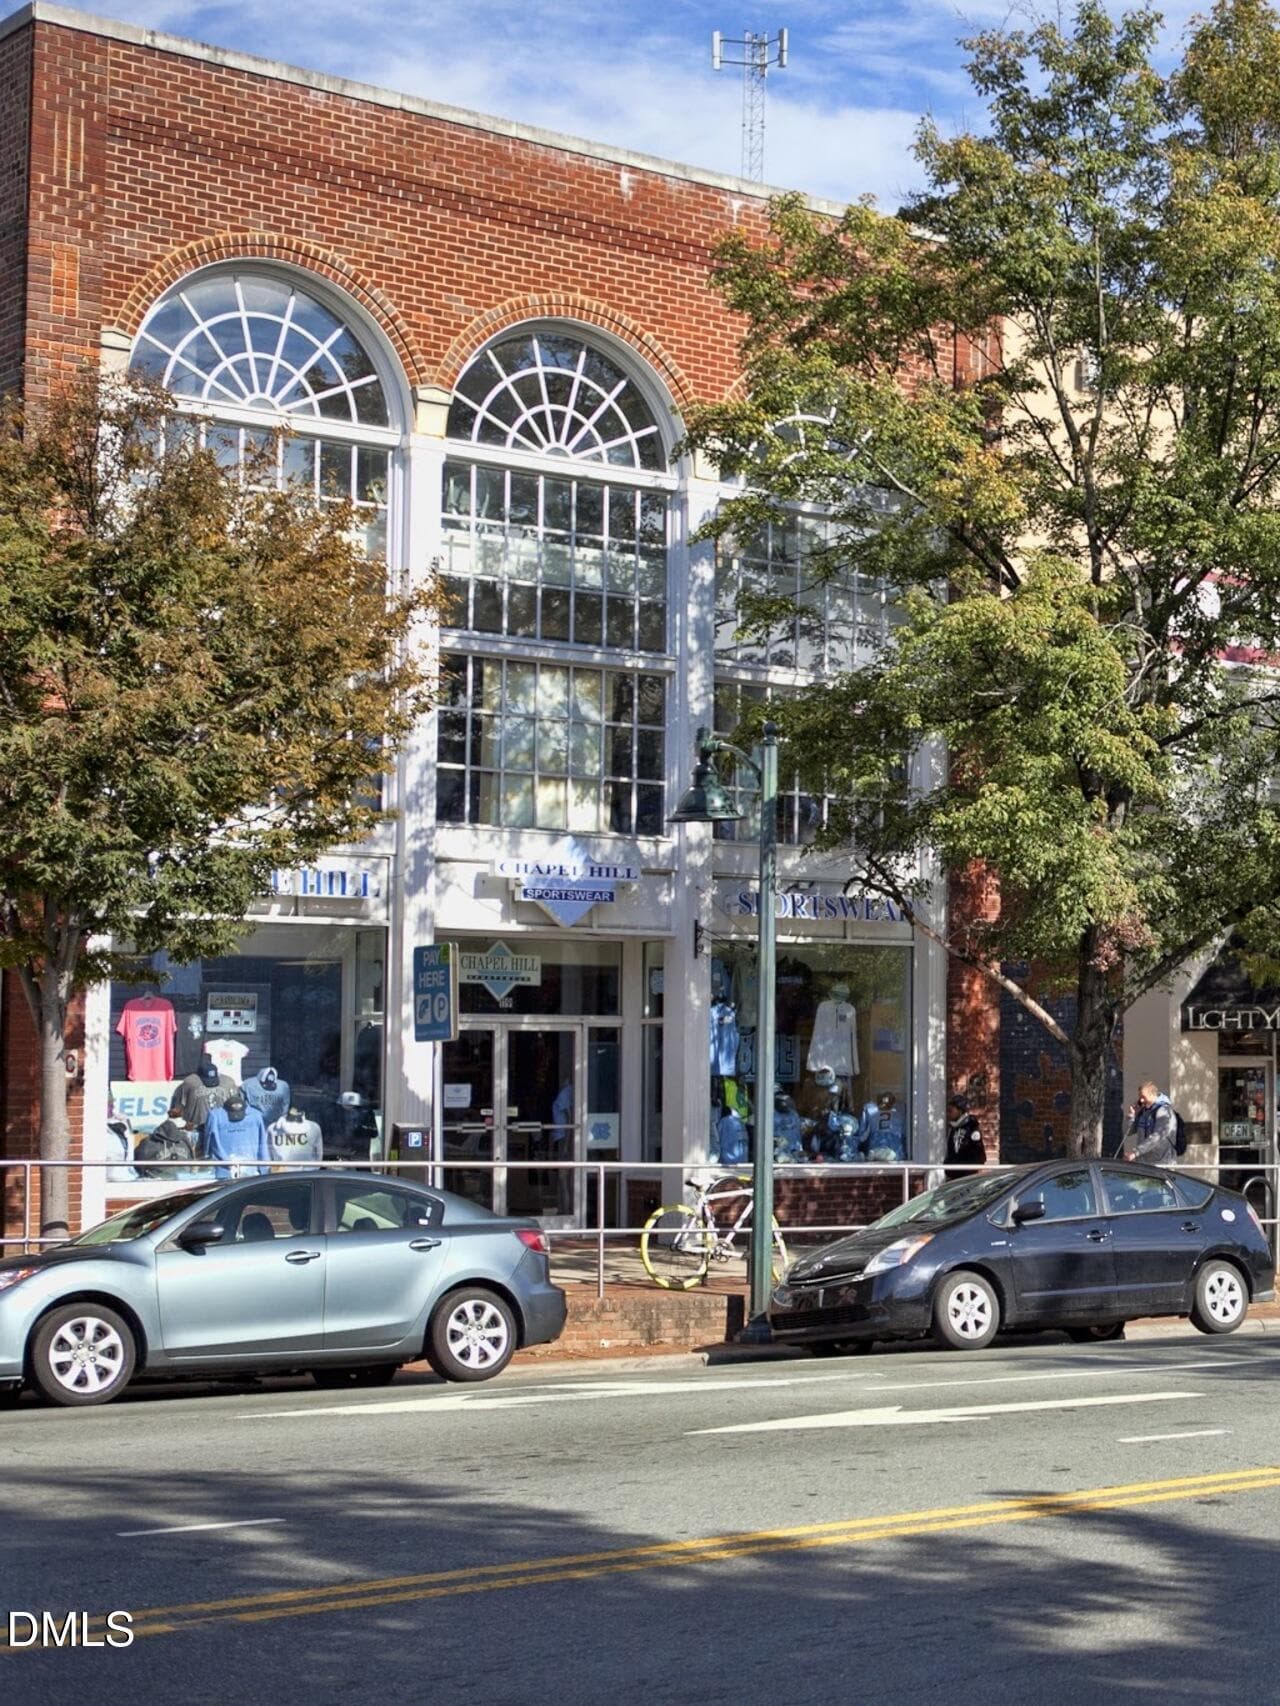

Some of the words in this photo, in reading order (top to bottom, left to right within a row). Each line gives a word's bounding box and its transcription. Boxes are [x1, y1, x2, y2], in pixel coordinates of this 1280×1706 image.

[588, 866, 638, 879] HILL
[300, 869, 380, 897] HILL
[525, 888, 611, 901] SPORTSWEAR
[737, 891, 915, 922] SORTSWEA
[423, 951, 441, 967] PAY
[460, 955, 508, 970] CHAPEL
[511, 957, 539, 972] HILL
[418, 970, 445, 988] HERE
[113, 1096, 169, 1118] ELS
[274, 1132, 309, 1147] UNC
